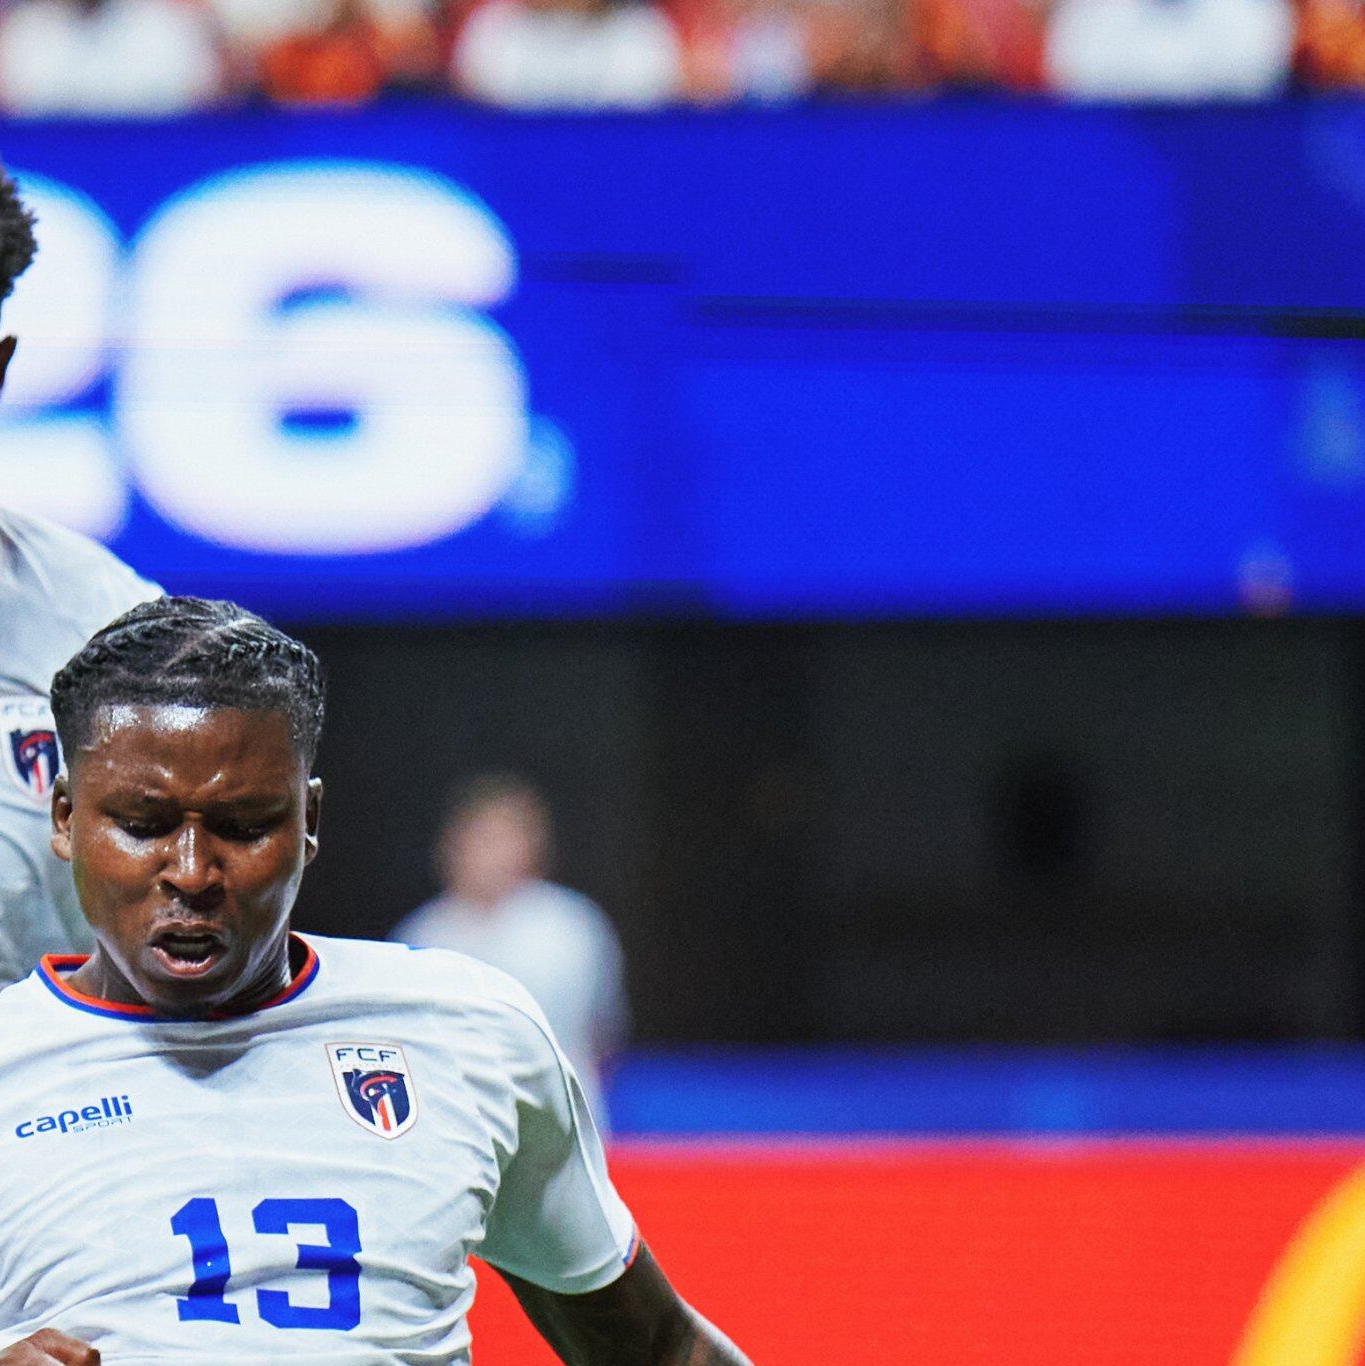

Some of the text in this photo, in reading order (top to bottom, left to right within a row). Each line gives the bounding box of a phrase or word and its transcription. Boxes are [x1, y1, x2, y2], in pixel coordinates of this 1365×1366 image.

[335, 1047, 397, 1063] FCF
[15, 1095, 133, 1139] capelli
[170, 1196, 363, 1332] 13
